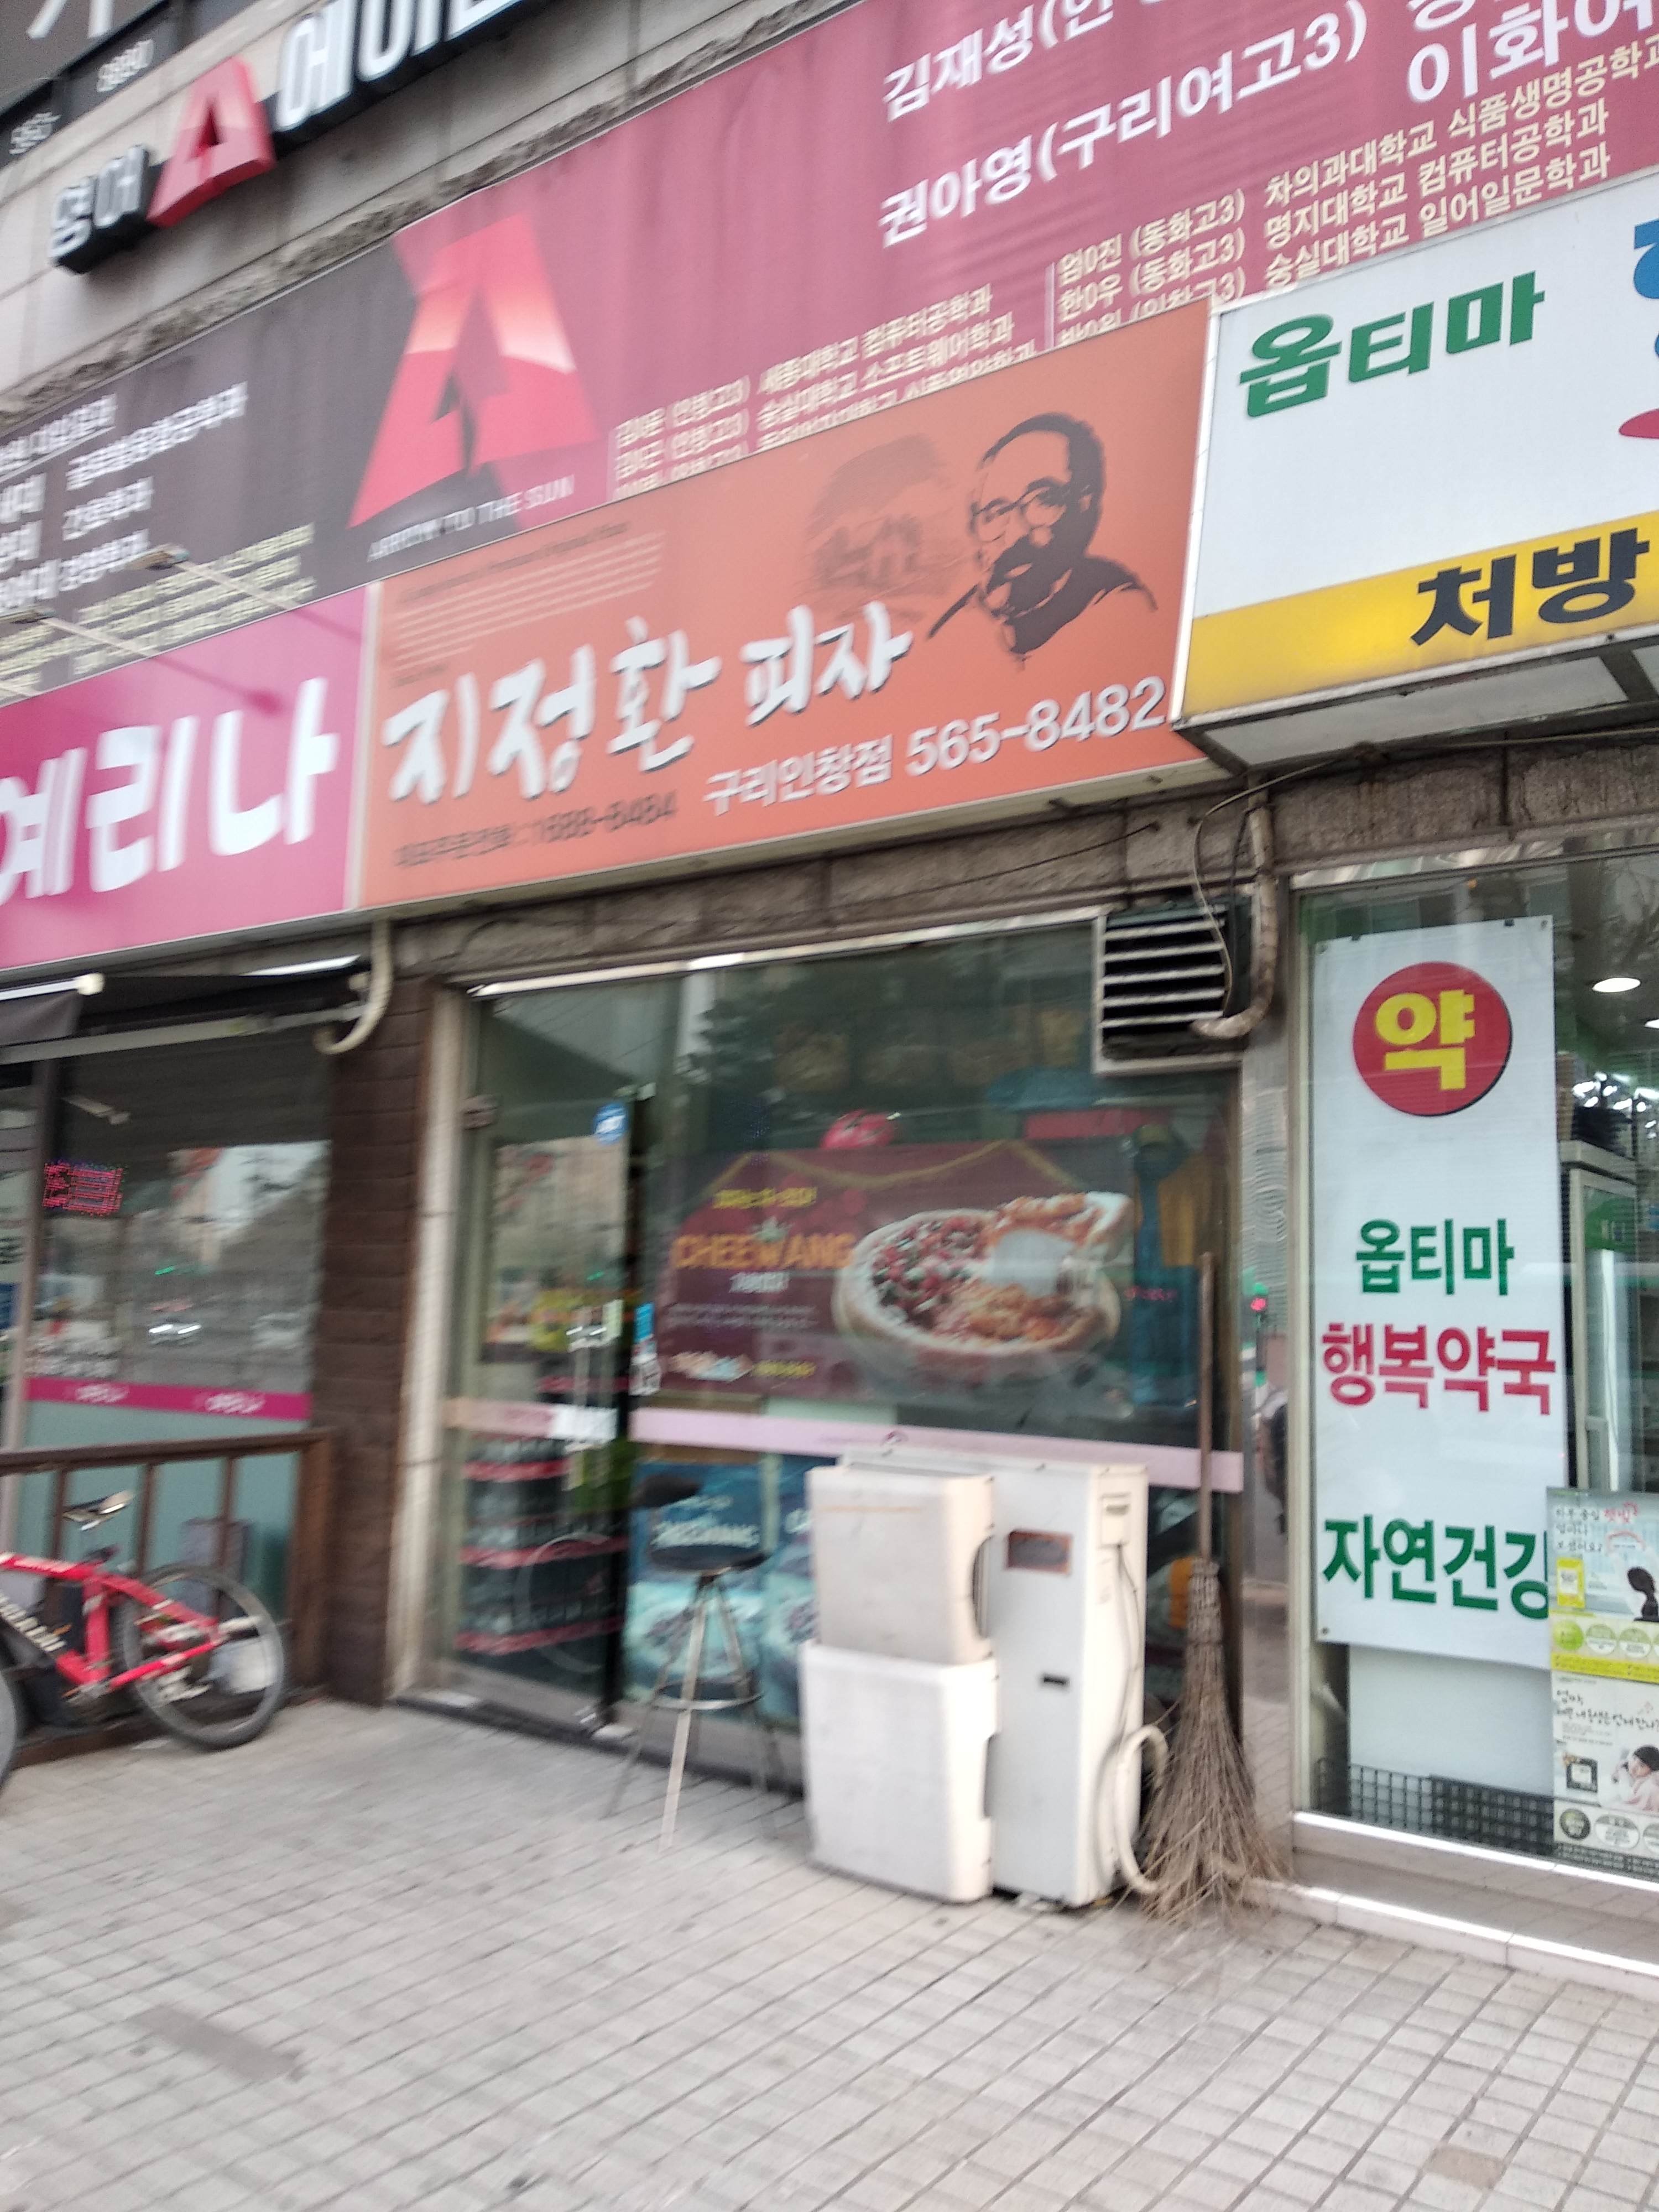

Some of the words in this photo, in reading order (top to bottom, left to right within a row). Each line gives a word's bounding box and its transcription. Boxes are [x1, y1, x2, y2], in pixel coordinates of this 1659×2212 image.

[883, 0, 1162, 123] 김재성(인
[1265, 119, 1437, 208] 차의과대학교
[1265, 171, 1408, 251] 명지대학교
[1417, 98, 1610, 198] 컴퓨터공학과
[1265, 213, 1410, 289] 숭실대학교
[1419, 142, 1611, 237] 일어일문학과
[1239, 270, 1546, 419] 옵티마
[1411, 528, 1650, 647] 처방
[382, 615, 722, 804] 지정환
[740, 599, 914, 727] 피자
[702, 734, 893, 816] 구리인창점
[905, 675, 1167, 777] 565-8482
[1374, 989, 1476, 1091] 약
[1355, 1218, 1515, 1296] 옵티마
[1322, 1322, 1557, 1416] 행복약국
[1322, 1514, 1548, 1620] 자연건강
